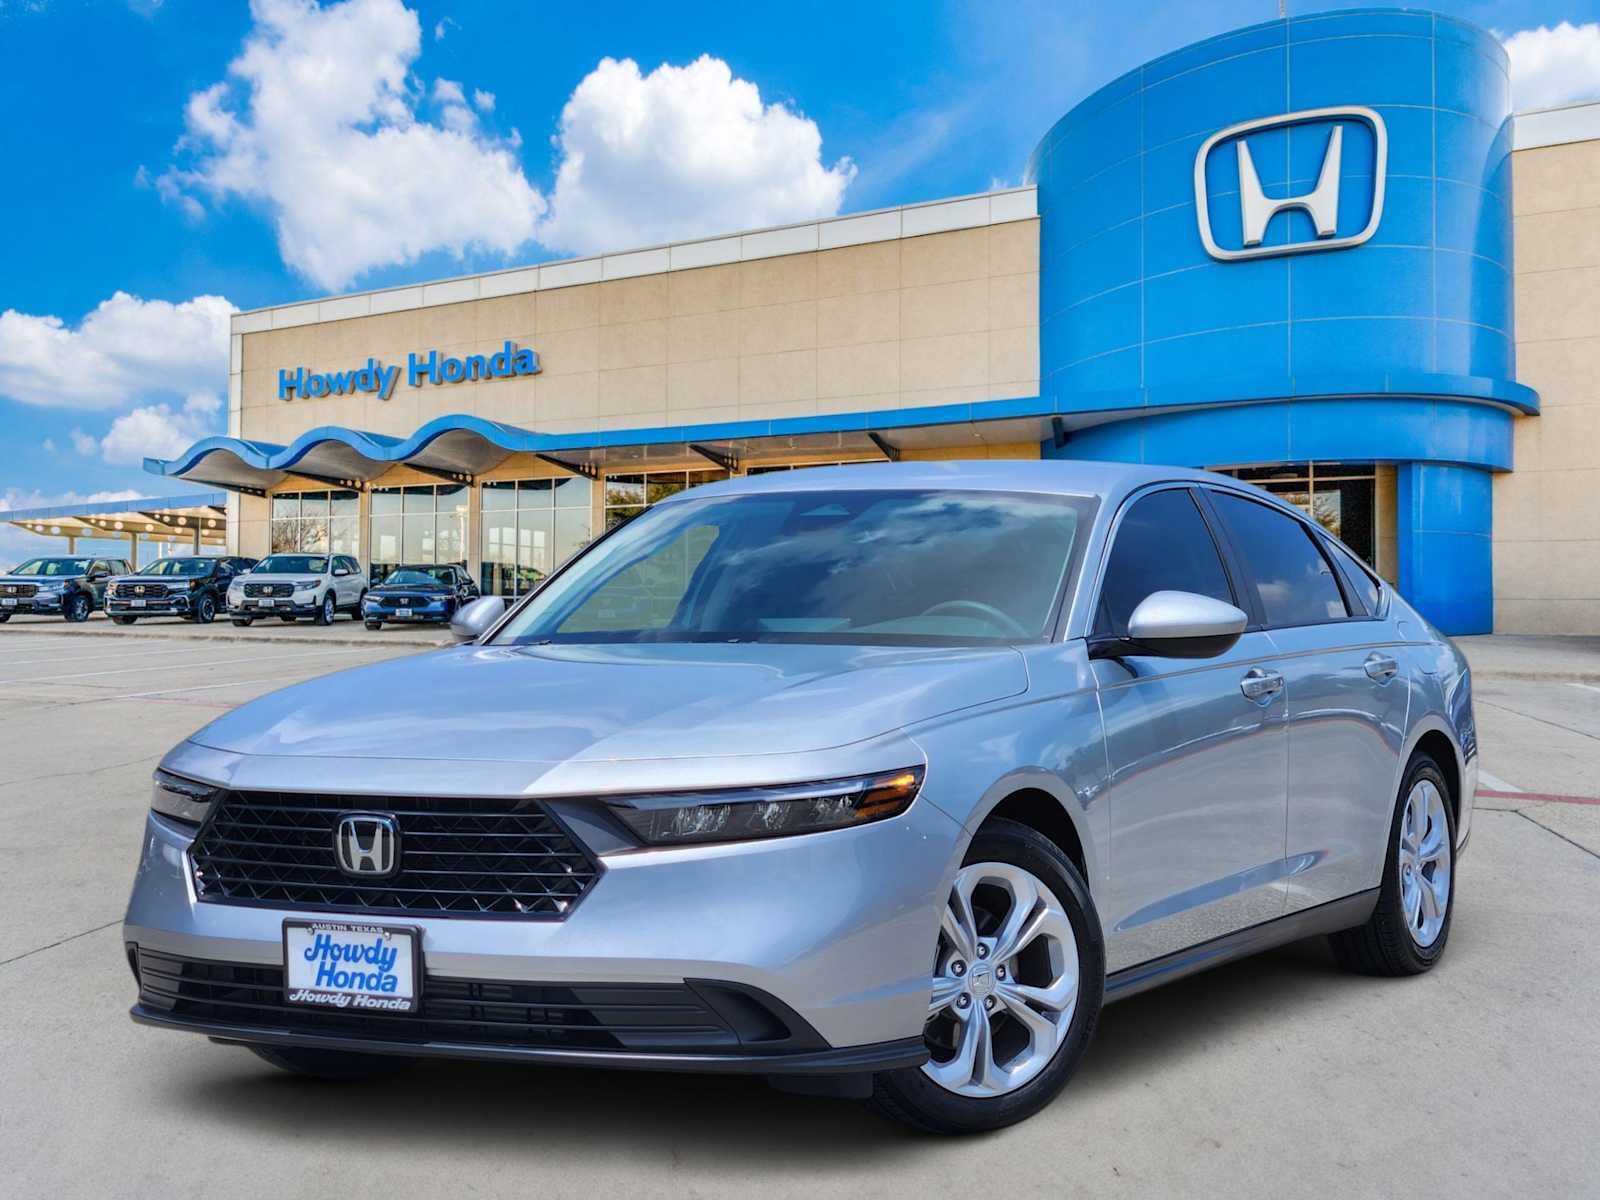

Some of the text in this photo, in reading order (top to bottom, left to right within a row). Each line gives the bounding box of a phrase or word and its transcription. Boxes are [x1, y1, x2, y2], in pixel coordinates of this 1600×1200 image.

[278, 340, 541, 401] Howdy Honda
[311, 922, 384, 934] AUSTIN TEXAS
[304, 933, 398, 973] Howdy
[315, 960, 399, 993] Honda
[289, 989, 411, 1010] Howdy Honda
